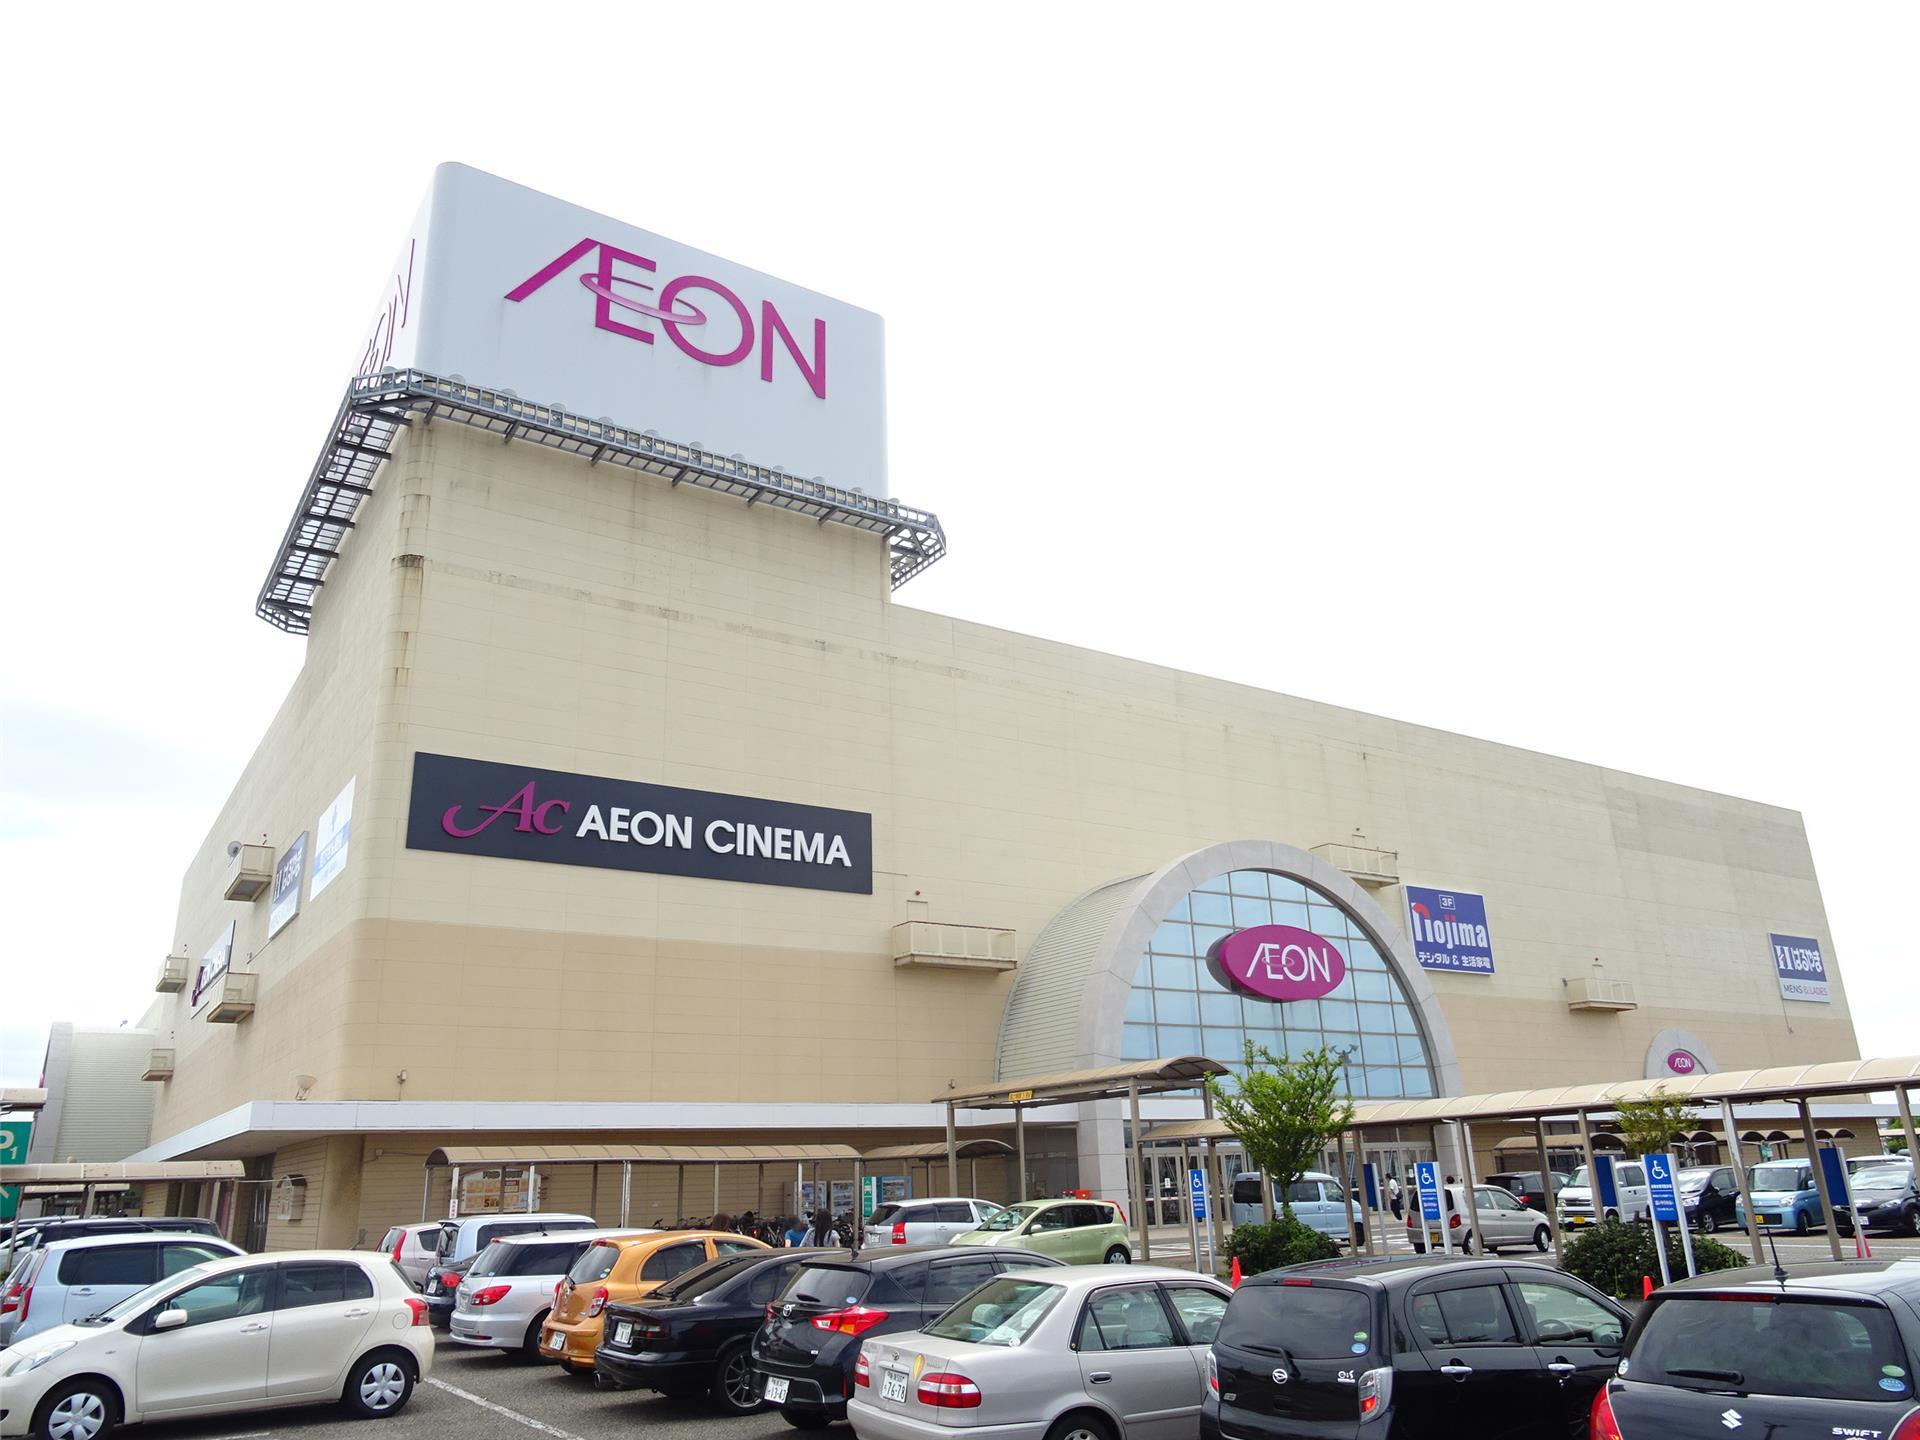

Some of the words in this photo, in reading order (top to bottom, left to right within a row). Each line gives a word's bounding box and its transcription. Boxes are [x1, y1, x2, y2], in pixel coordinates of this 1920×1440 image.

[575, 804, 694, 849] AEON
[704, 819, 853, 868] CINEMA
[1441, 897, 1453, 908] 3F
[1831, 1427, 1882, 1438] SWIFT
